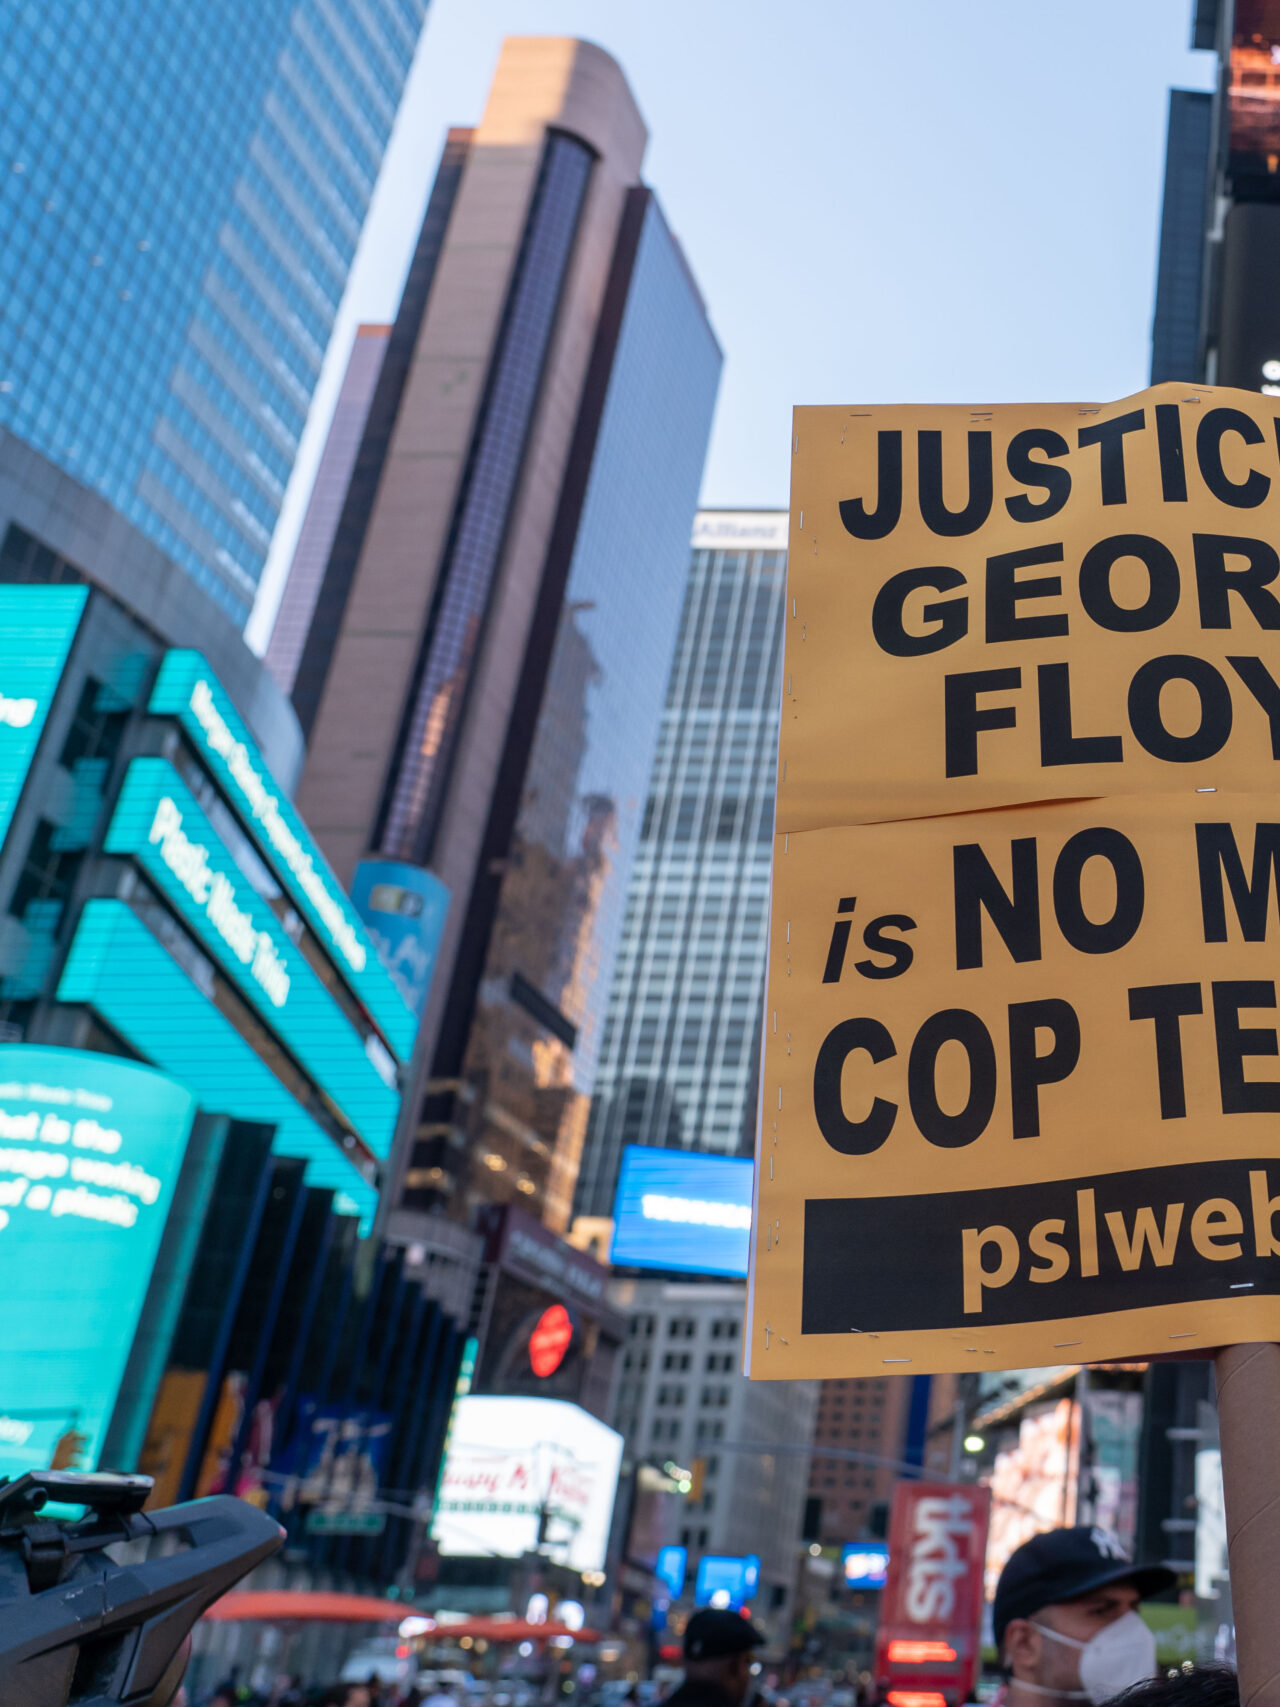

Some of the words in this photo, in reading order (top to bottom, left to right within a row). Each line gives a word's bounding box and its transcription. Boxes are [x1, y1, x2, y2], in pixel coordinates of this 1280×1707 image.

[822, 897, 917, 983] is
[953, 827, 1144, 970] NO
[814, 999, 1080, 1155] COP
[907, 1494, 972, 1624] tkts
